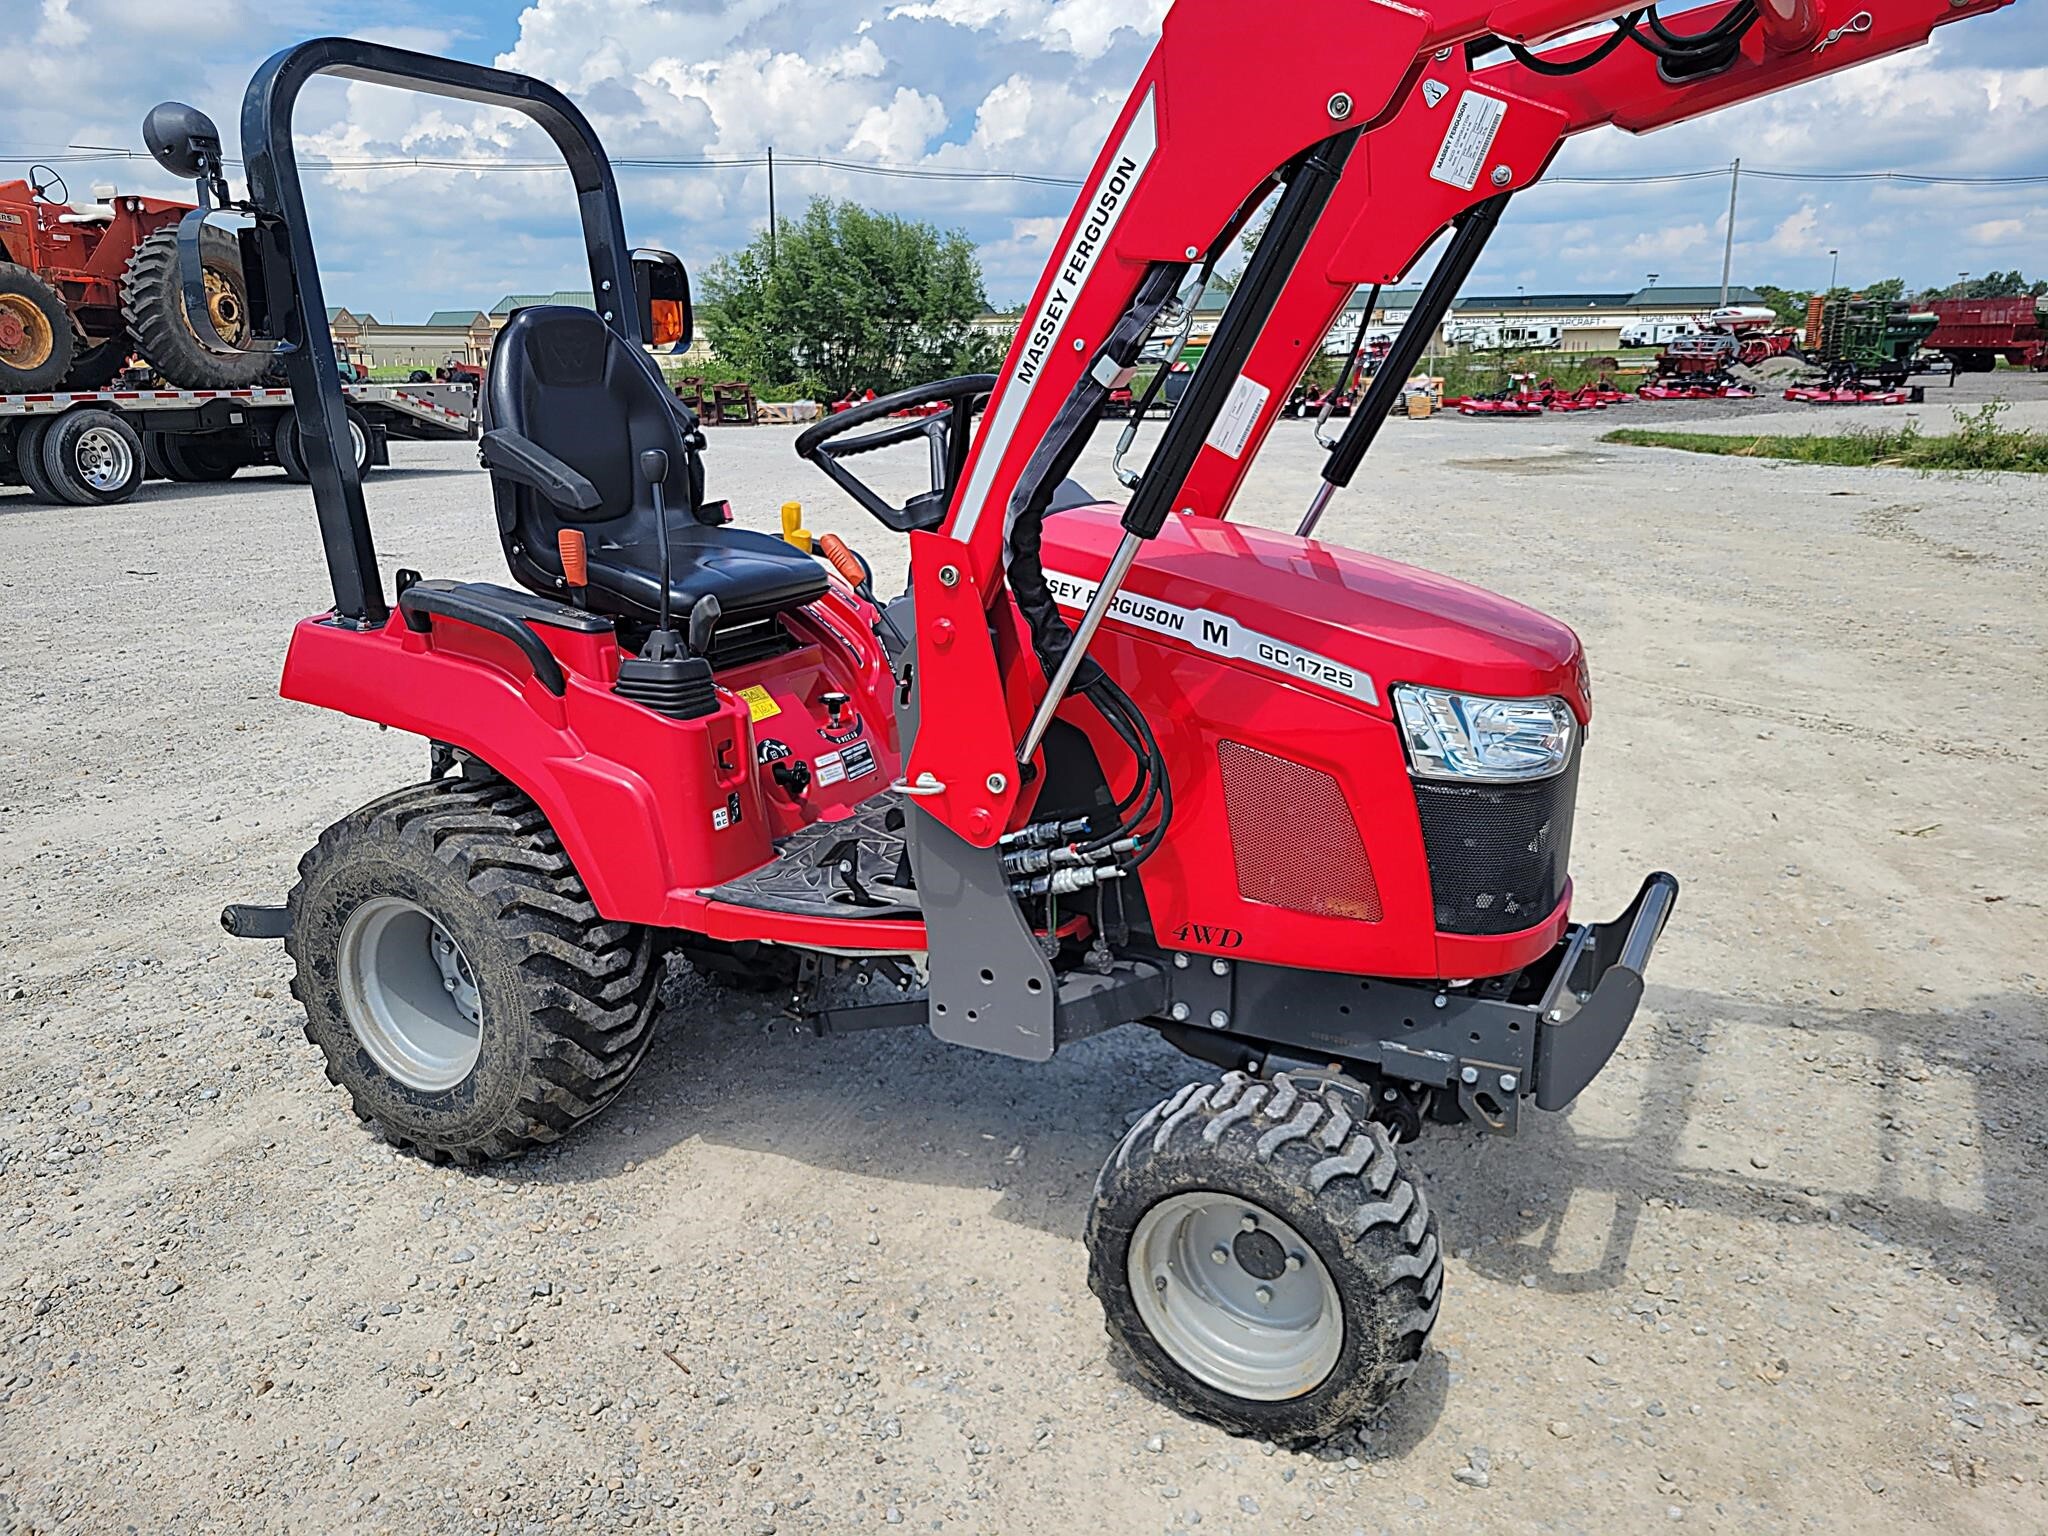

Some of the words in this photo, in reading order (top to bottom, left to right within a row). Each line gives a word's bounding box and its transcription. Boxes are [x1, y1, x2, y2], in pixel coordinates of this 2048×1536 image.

[1436, 139, 1452, 169] MASSEY
[1449, 102, 1468, 140] FERGUSON
[1017, 291, 1070, 386] MASSEY
[1063, 156, 1137, 287] FERGUSON
[1086, 589, 1185, 631] FRGUSON
[1202, 620, 1229, 647] M
[1172, 921, 1243, 948] 4WD
